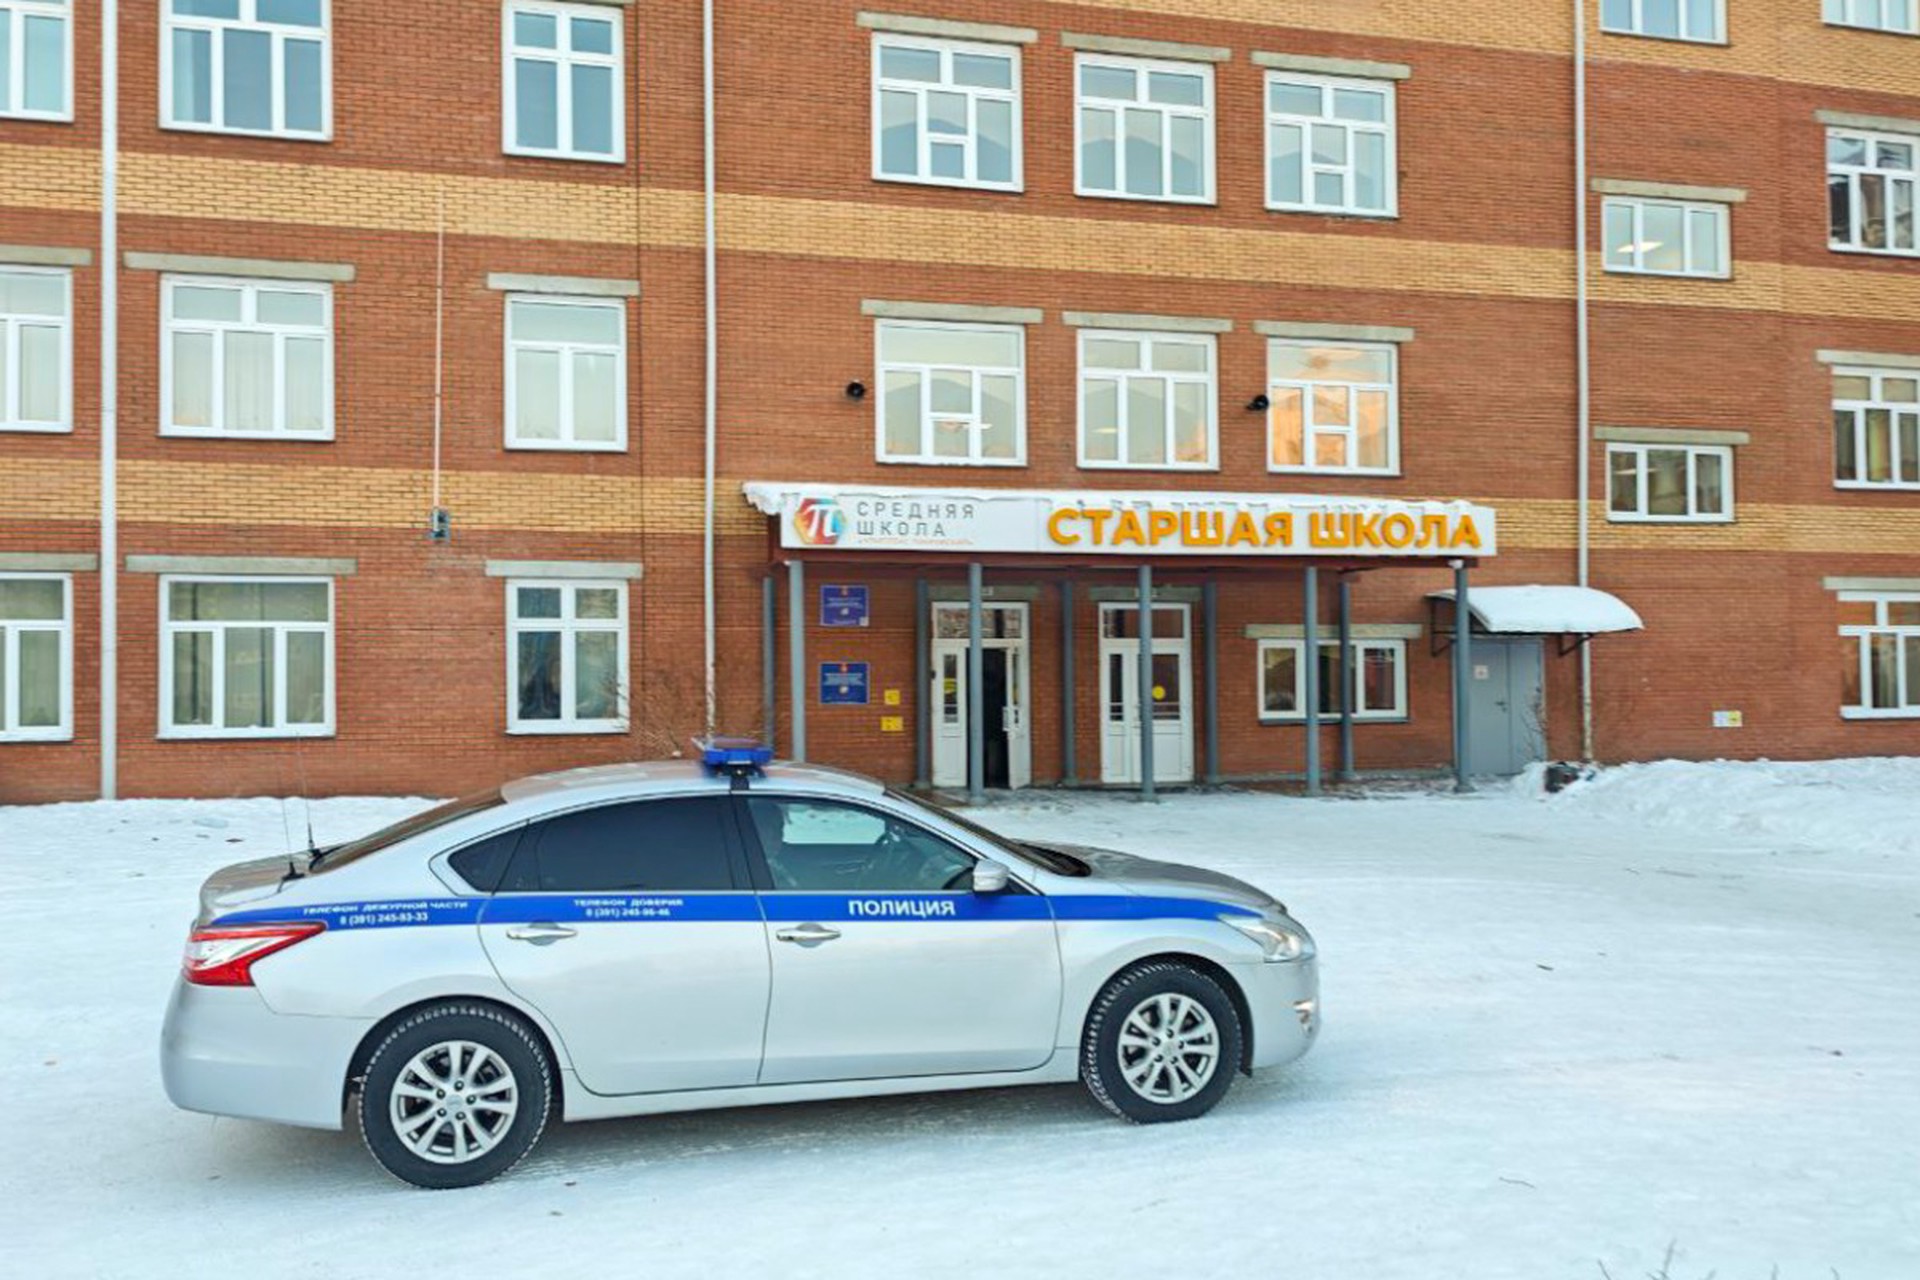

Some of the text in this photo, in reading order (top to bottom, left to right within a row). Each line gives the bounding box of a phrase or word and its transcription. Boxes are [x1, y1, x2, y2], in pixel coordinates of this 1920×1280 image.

[857, 501, 974, 519] СРЕДНЯЯ
[857, 522, 946, 537] ШКОЛА
[1047, 508, 1482, 549] СТАРШАЯ ШКОЛА
[303, 901, 468, 915] ТЕЛЕФОН ДЕЖУРНОЙ ЧАСТИ
[573, 898, 684, 907] ТЕЛЕФОН ДОВЕРИЯ
[848, 899, 956, 919] ПОЛИЦИЯ
